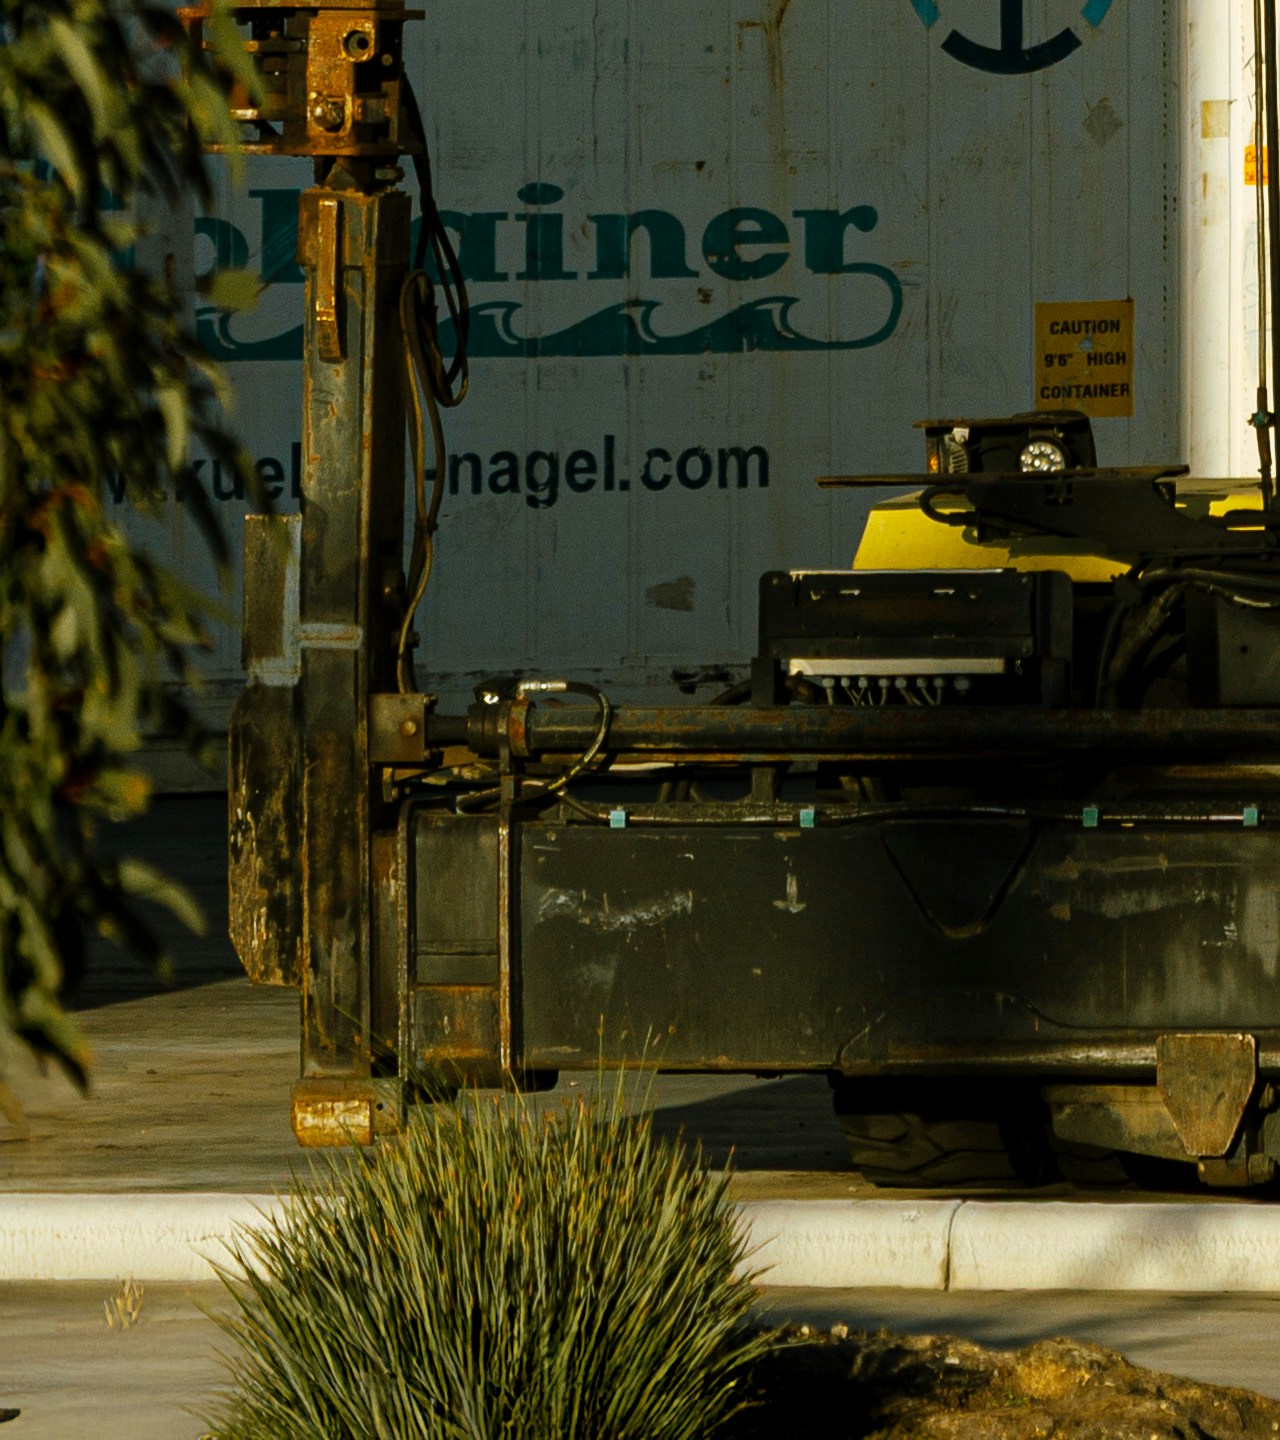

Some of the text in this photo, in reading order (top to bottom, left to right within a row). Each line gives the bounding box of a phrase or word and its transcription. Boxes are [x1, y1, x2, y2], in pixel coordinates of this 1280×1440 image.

[1049, 319, 1120, 336] CAUTION
[1086, 351, 1127, 367] HIGH
[1040, 382, 1131, 401] CONTAINER
